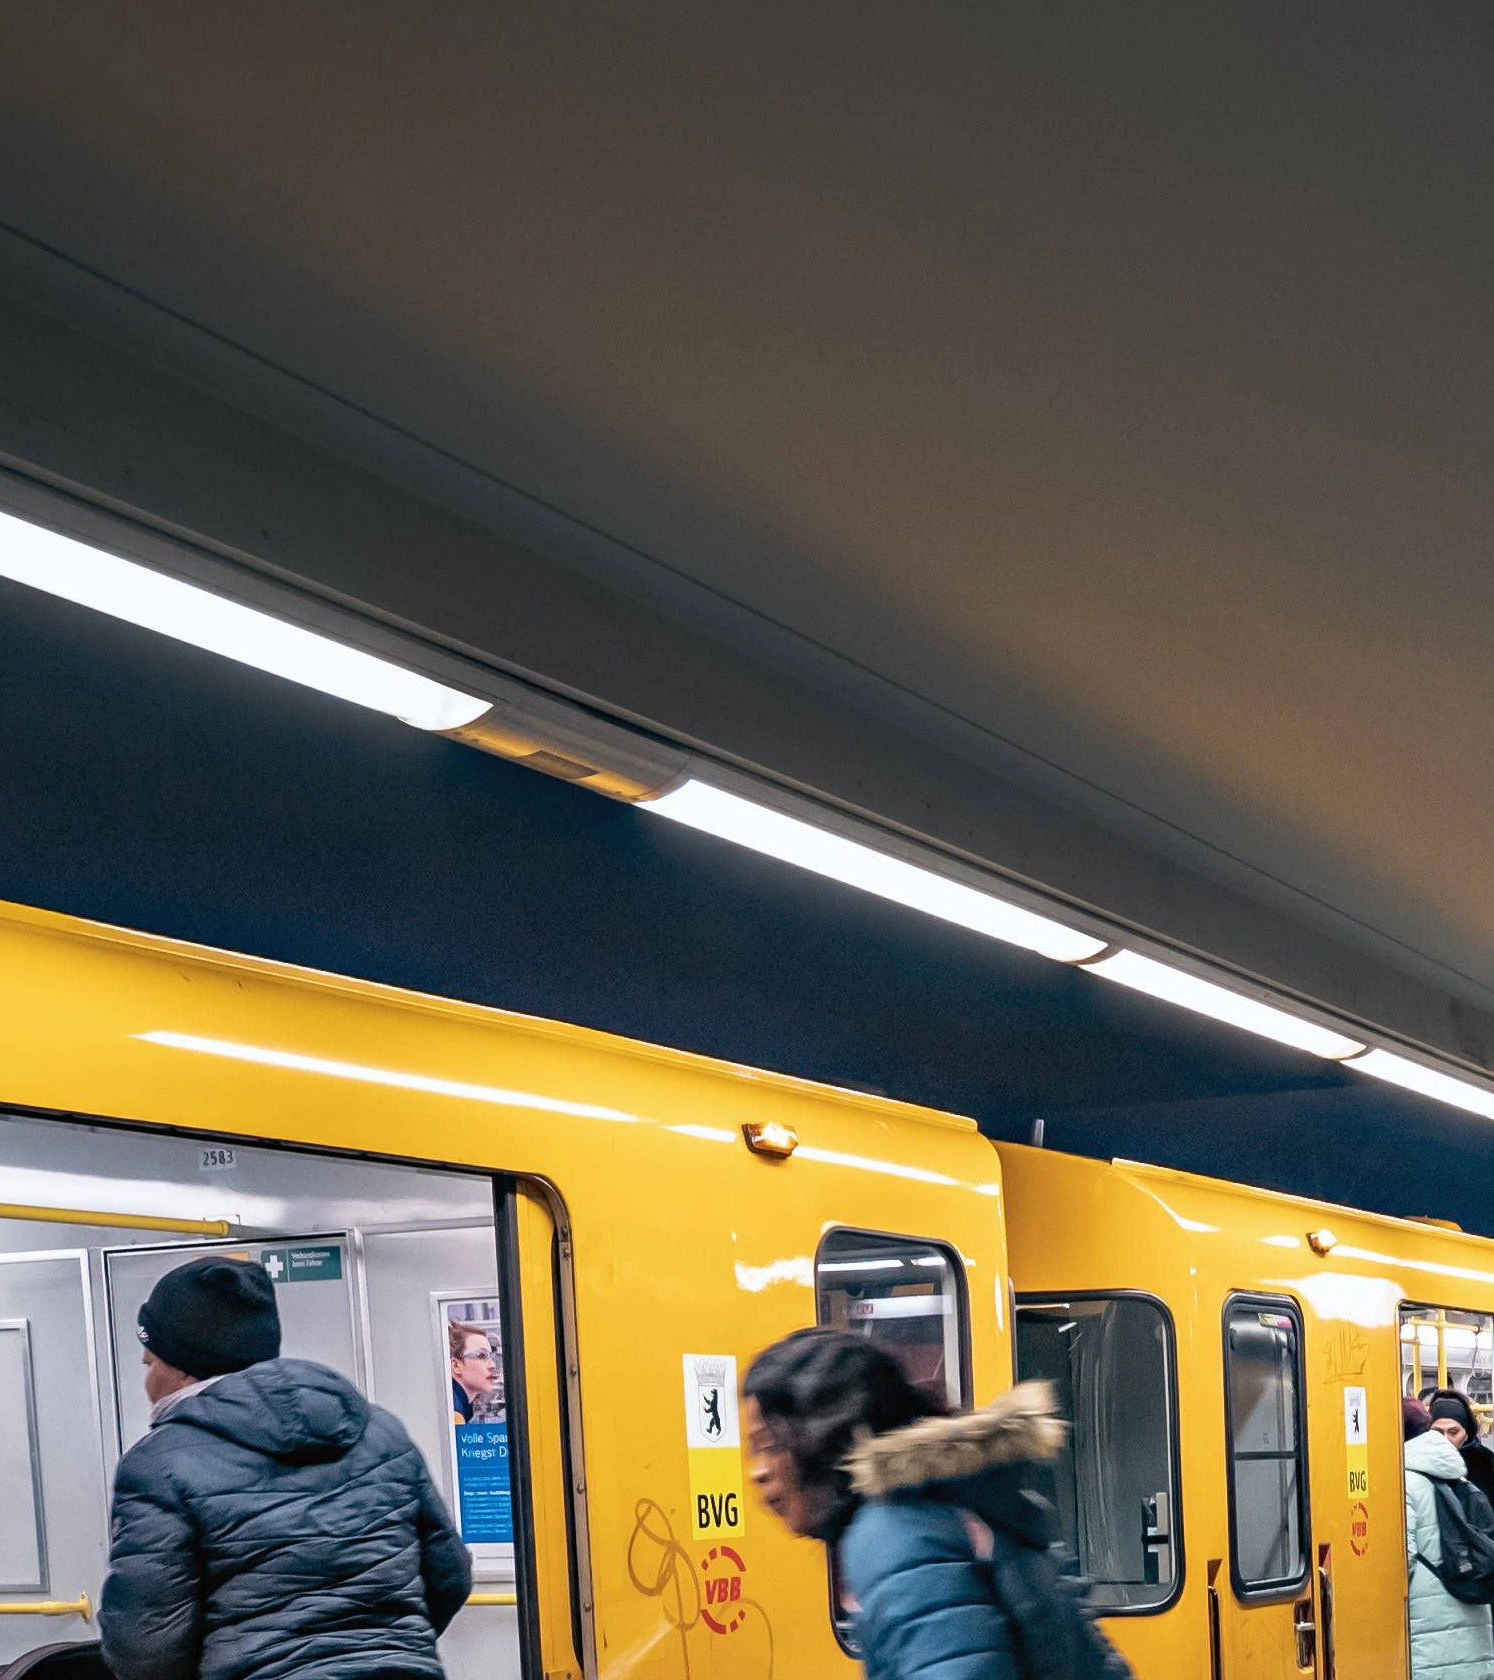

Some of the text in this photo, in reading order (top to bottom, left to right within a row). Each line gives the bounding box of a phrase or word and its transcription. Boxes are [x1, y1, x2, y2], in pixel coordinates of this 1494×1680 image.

[203, 1149, 234, 1166] 2583
[461, 1432, 484, 1443] Volle
[1349, 1471, 1367, 1493] BVG
[697, 1492, 738, 1528] BVG
[705, 1577, 742, 1605] VBB
